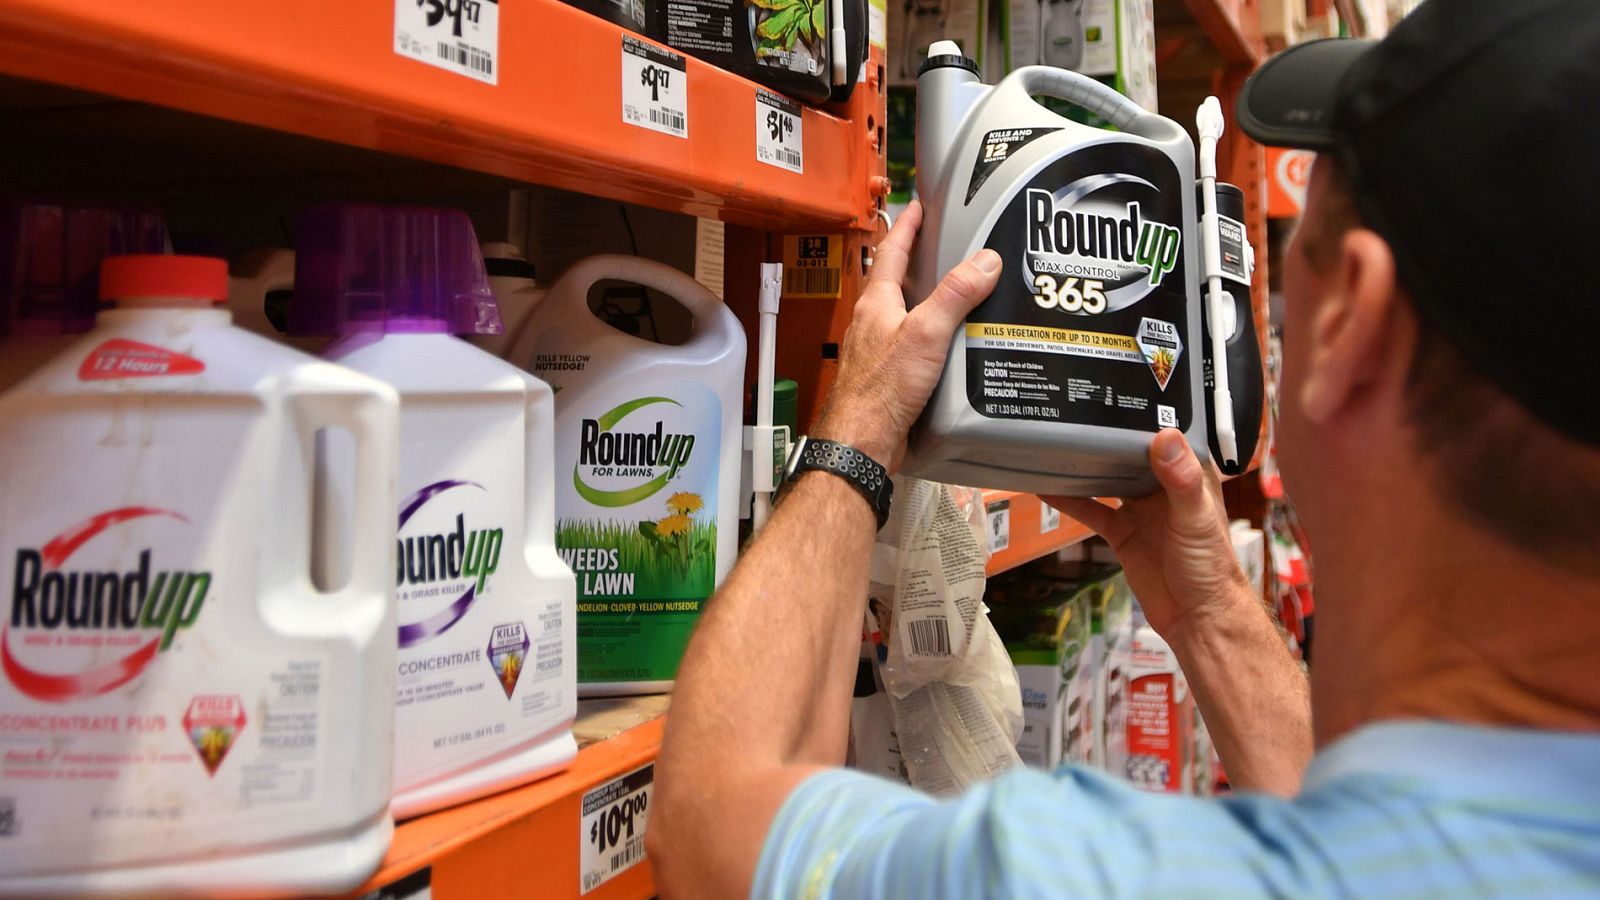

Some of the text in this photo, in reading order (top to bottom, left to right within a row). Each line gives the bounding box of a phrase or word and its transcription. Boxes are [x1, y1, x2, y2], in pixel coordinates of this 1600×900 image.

[986, 136, 1019, 144] PREVENTS
[988, 130, 1012, 139] KILLS
[985, 142, 1009, 158] 12
[1026, 188, 1181, 286] Roundup
[1220, 227, 1241, 242] WAND
[1034, 260, 1120, 280] MAX CONTROL
[1033, 274, 1107, 315] 365
[1146, 321, 1173, 335] KILLS
[984, 327, 1132, 348] KILLS VEGETATION FOR UP TO 12 MONTHS
[536, 354, 590, 362] KILLS YELLOW
[1106, 350, 1124, 358] GRAVEL
[94, 355, 169, 374] 12 Hours
[535, 362, 585, 371] NUTSEDGE!
[984, 360, 995, 368] Keep
[984, 368, 1008, 378] CAUTION
[985, 404, 997, 414] NET
[999, 404, 1010, 415] 1.33
[1010, 405, 1022, 416] GAL
[1023, 406, 1034, 416] (170
[1034, 406, 1041, 417] FL
[580, 419, 695, 480] Roundup
[592, 467, 613, 477] FOR
[559, 548, 619, 571] WEEDS
[411, 588, 439, 599] GRASS
[441, 584, 465, 595] KILLER
[583, 573, 635, 595] LAWN
[11, 548, 212, 653] Roundup
[576, 602, 699, 612] ANDELION CLOVER YELLOW NUTSEDGE
[496, 625, 521, 639] KILLS
[398, 650, 481, 676] CONCENTRATE
[0, 714, 167, 732] CONCENTRATE PLUS
[590, 791, 648, 854] $10900
